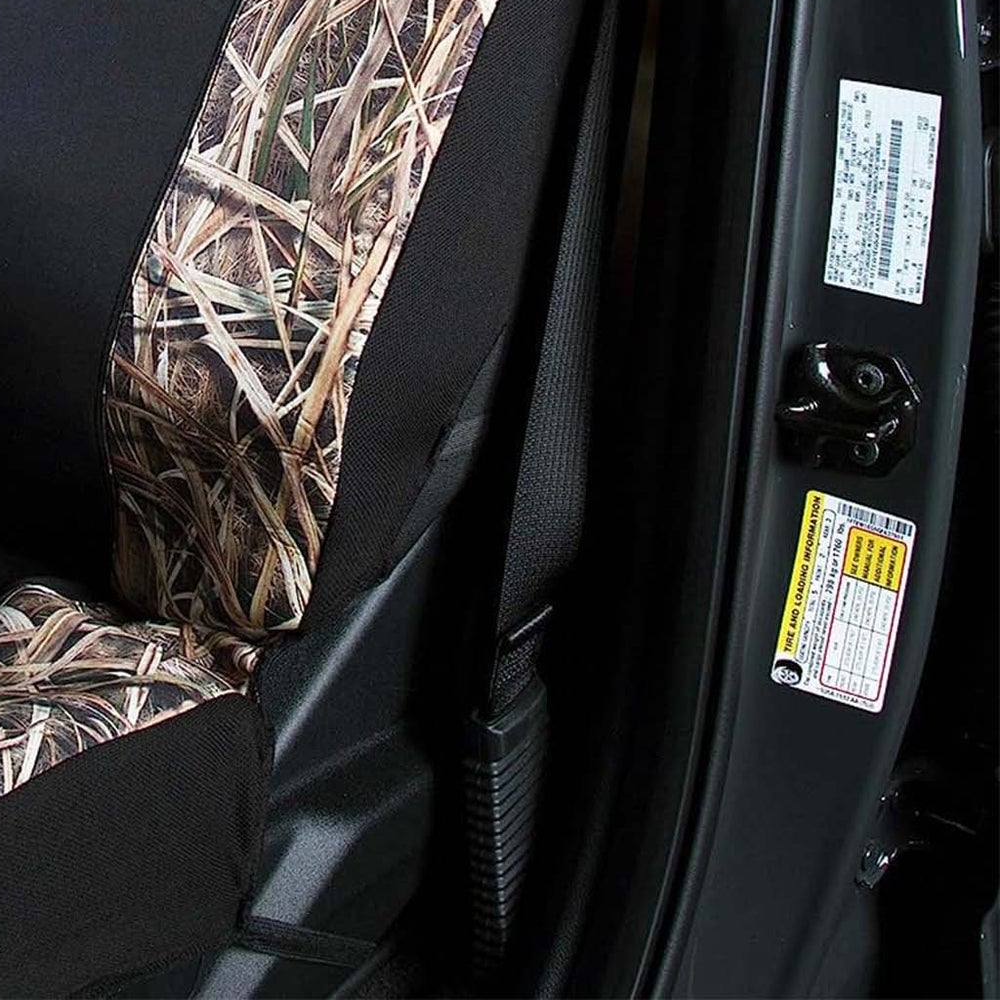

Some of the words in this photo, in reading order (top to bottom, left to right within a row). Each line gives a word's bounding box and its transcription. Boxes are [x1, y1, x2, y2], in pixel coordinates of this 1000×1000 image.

[785, 631, 795, 653] TIRE
[790, 609, 800, 629] AND
[796, 564, 809, 606] LOADING
[805, 496, 821, 562] INFORMATION
